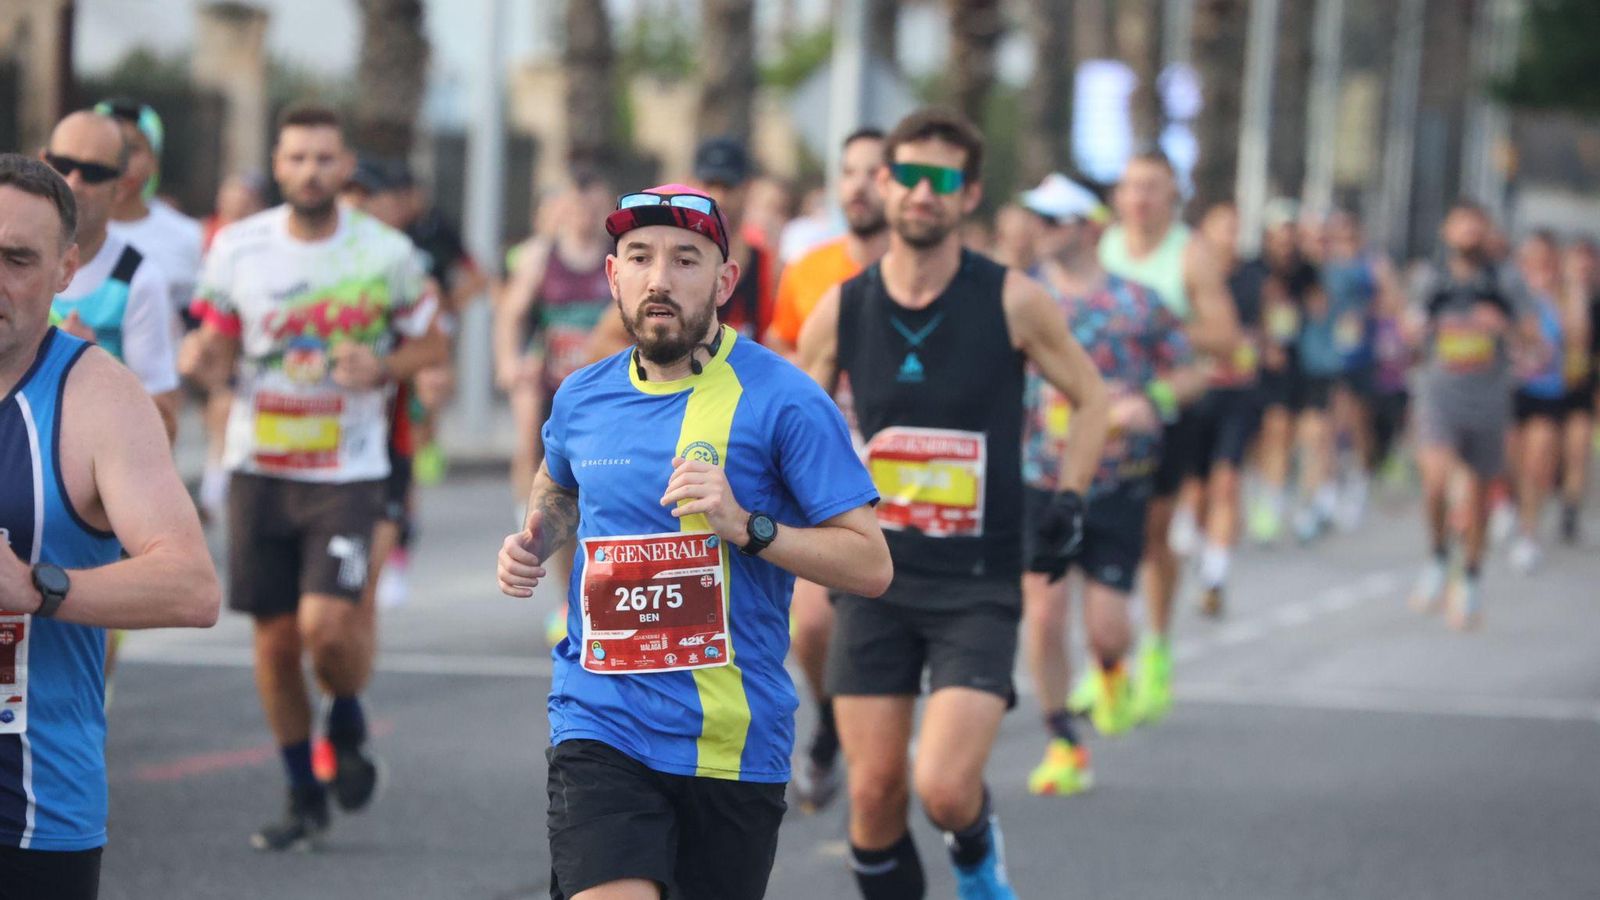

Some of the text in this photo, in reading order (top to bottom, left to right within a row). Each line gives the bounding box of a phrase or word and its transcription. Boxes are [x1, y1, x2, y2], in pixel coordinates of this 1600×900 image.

[614, 540, 709, 563] GENERALI
[615, 584, 683, 611] 2675
[639, 613, 660, 622] BEN
[679, 636, 706, 647] 42K
